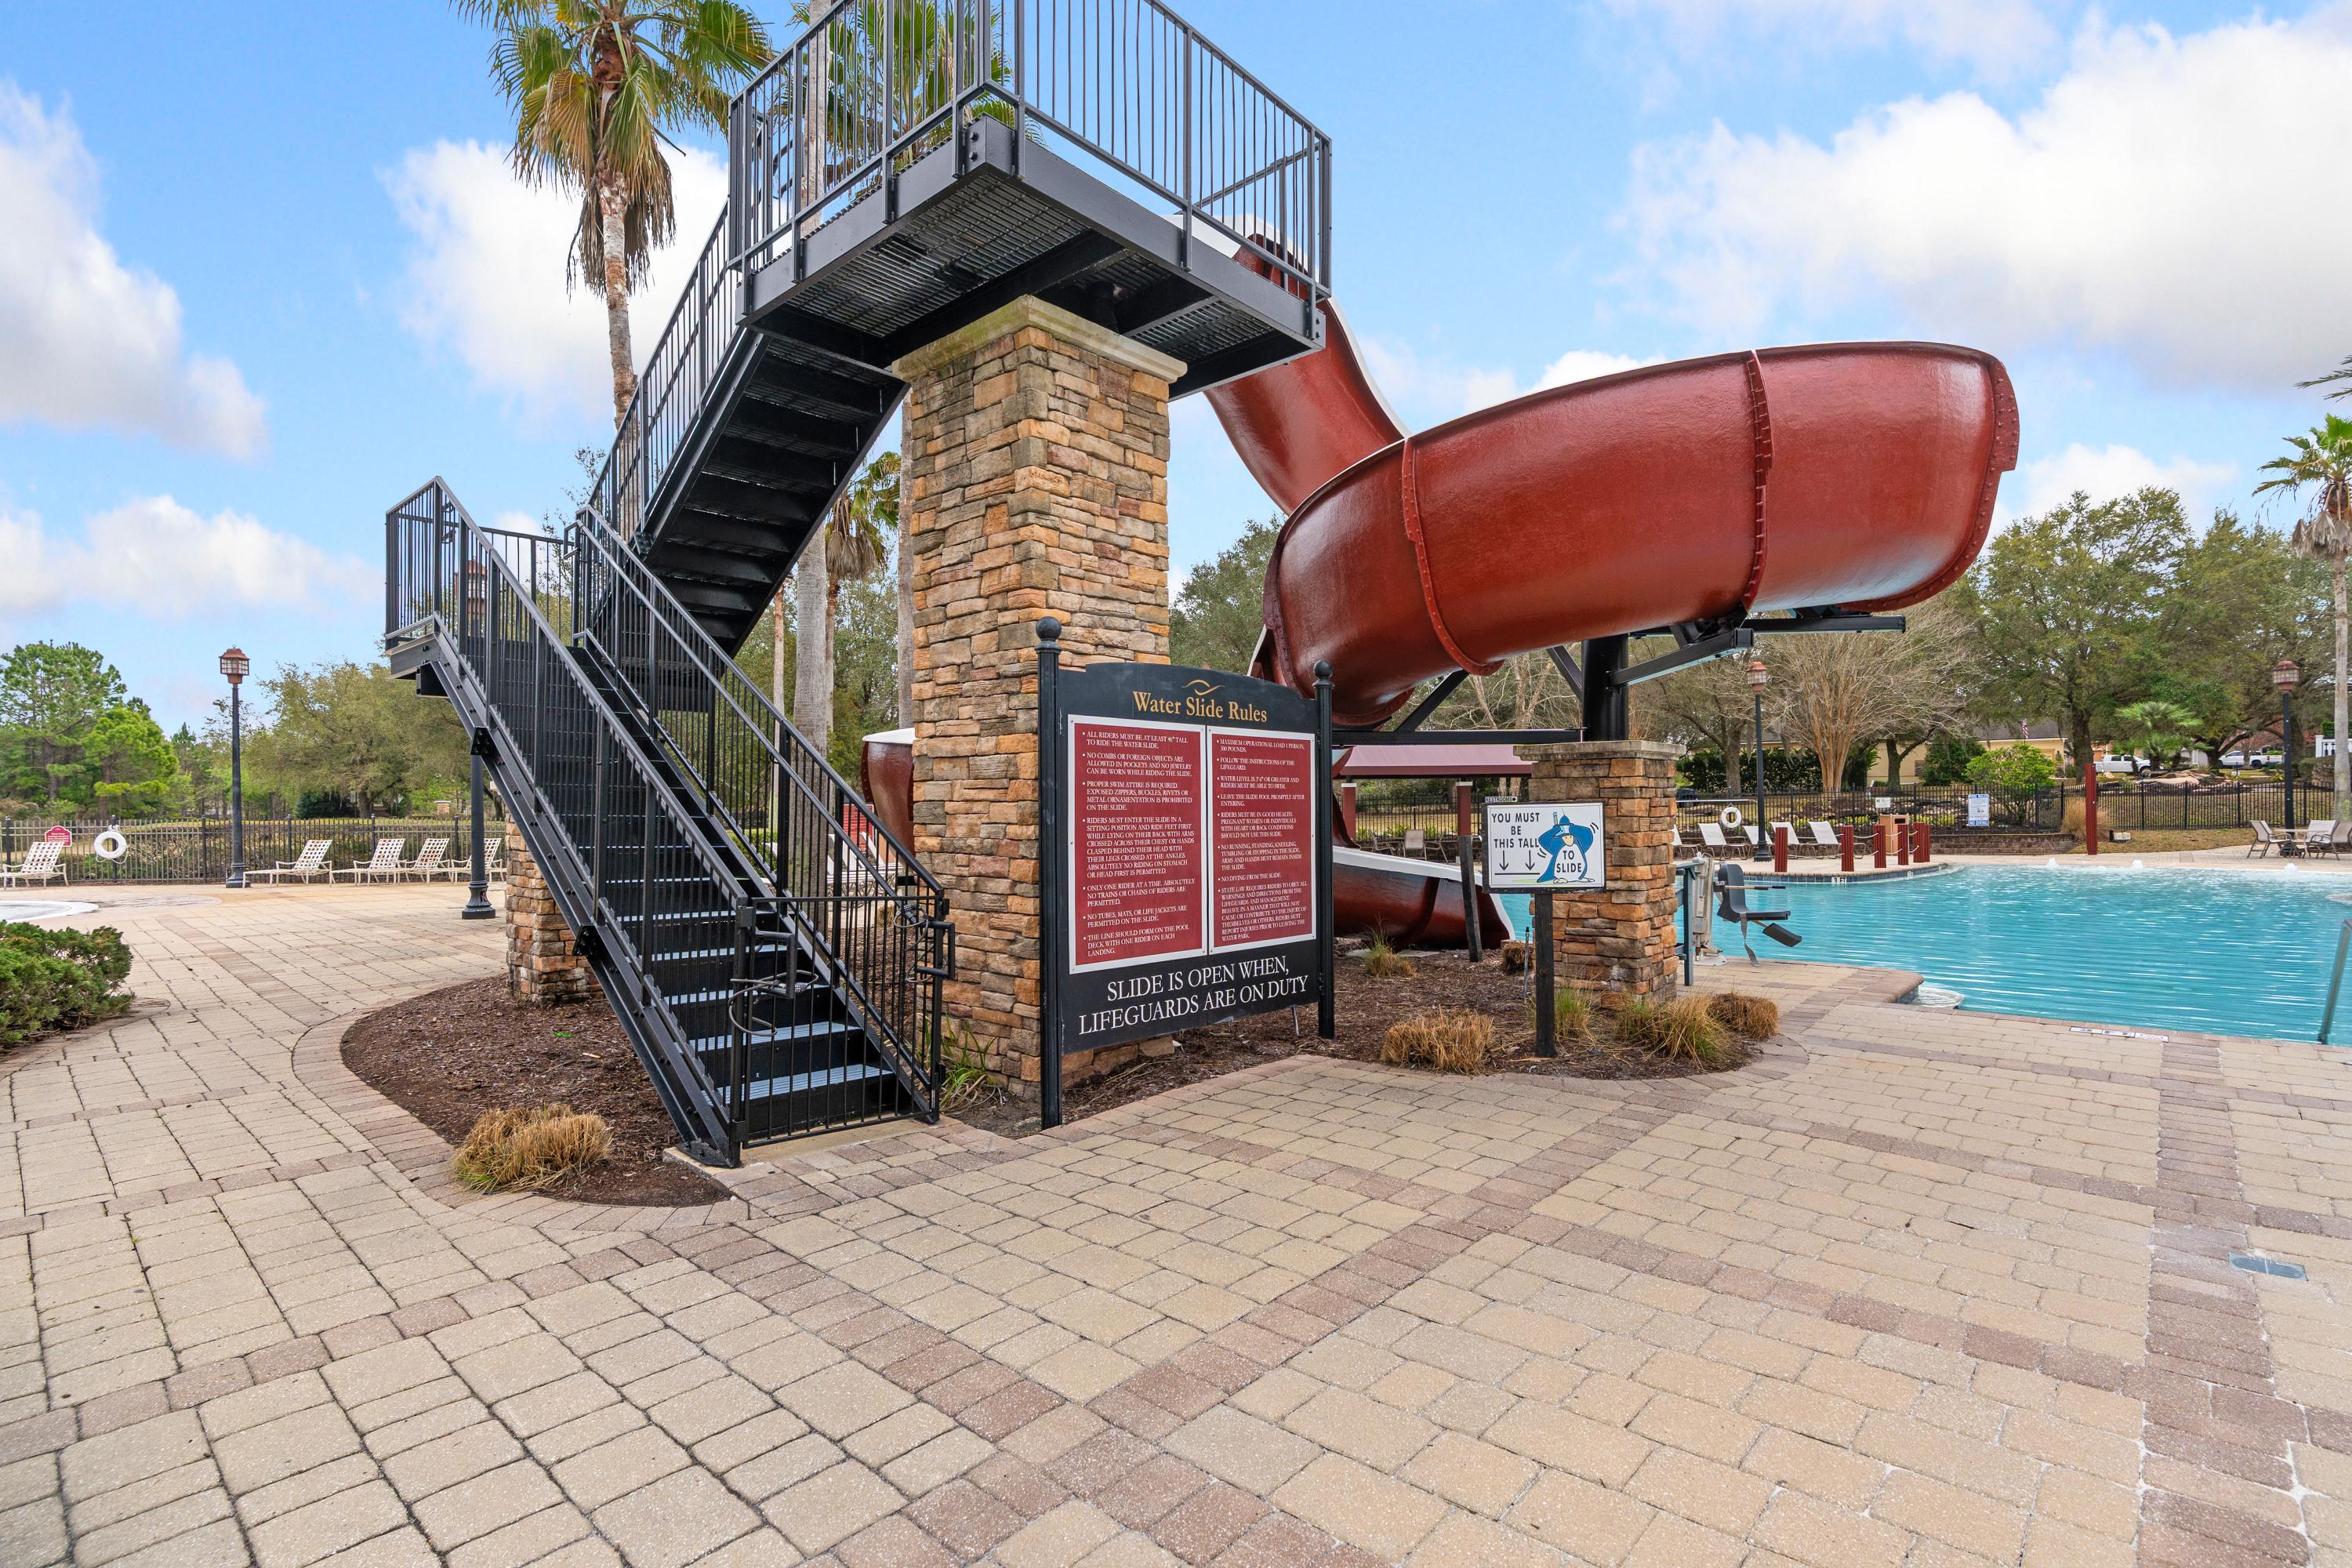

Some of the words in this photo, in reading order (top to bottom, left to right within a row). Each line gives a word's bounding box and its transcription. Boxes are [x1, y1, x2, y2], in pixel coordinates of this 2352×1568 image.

[1133, 691, 1181, 714] Water
[1186, 696, 1223, 718] Slide
[1229, 701, 1267, 722] Rules
[1492, 813, 1511, 823] YOU
[1515, 812, 1540, 822] MUST
[1511, 826, 1522, 836] BE
[1494, 838, 1515, 848] THIS
[1518, 838, 1539, 848] TALL
[1563, 850, 1575, 860] TO
[1556, 862, 1582, 873] SLIDE
[1098, 912, 1116, 920] TUBES,
[1155, 906, 1177, 915] JACKETS
[1087, 919, 1121, 928] PERMITTED
[1115, 930, 1139, 938] SHOULD
[1107, 975, 1164, 1001] SLIDE
[1167, 971, 1183, 991] IS
[1189, 964, 1235, 988] OPEN
[1239, 955, 1289, 979] WHEN,
[1079, 994, 1199, 1035] LIFEGUARDS
[1203, 989, 1236, 1011] ARE
[1240, 982, 1264, 1004] ON
[1267, 975, 1308, 999] DUTY
